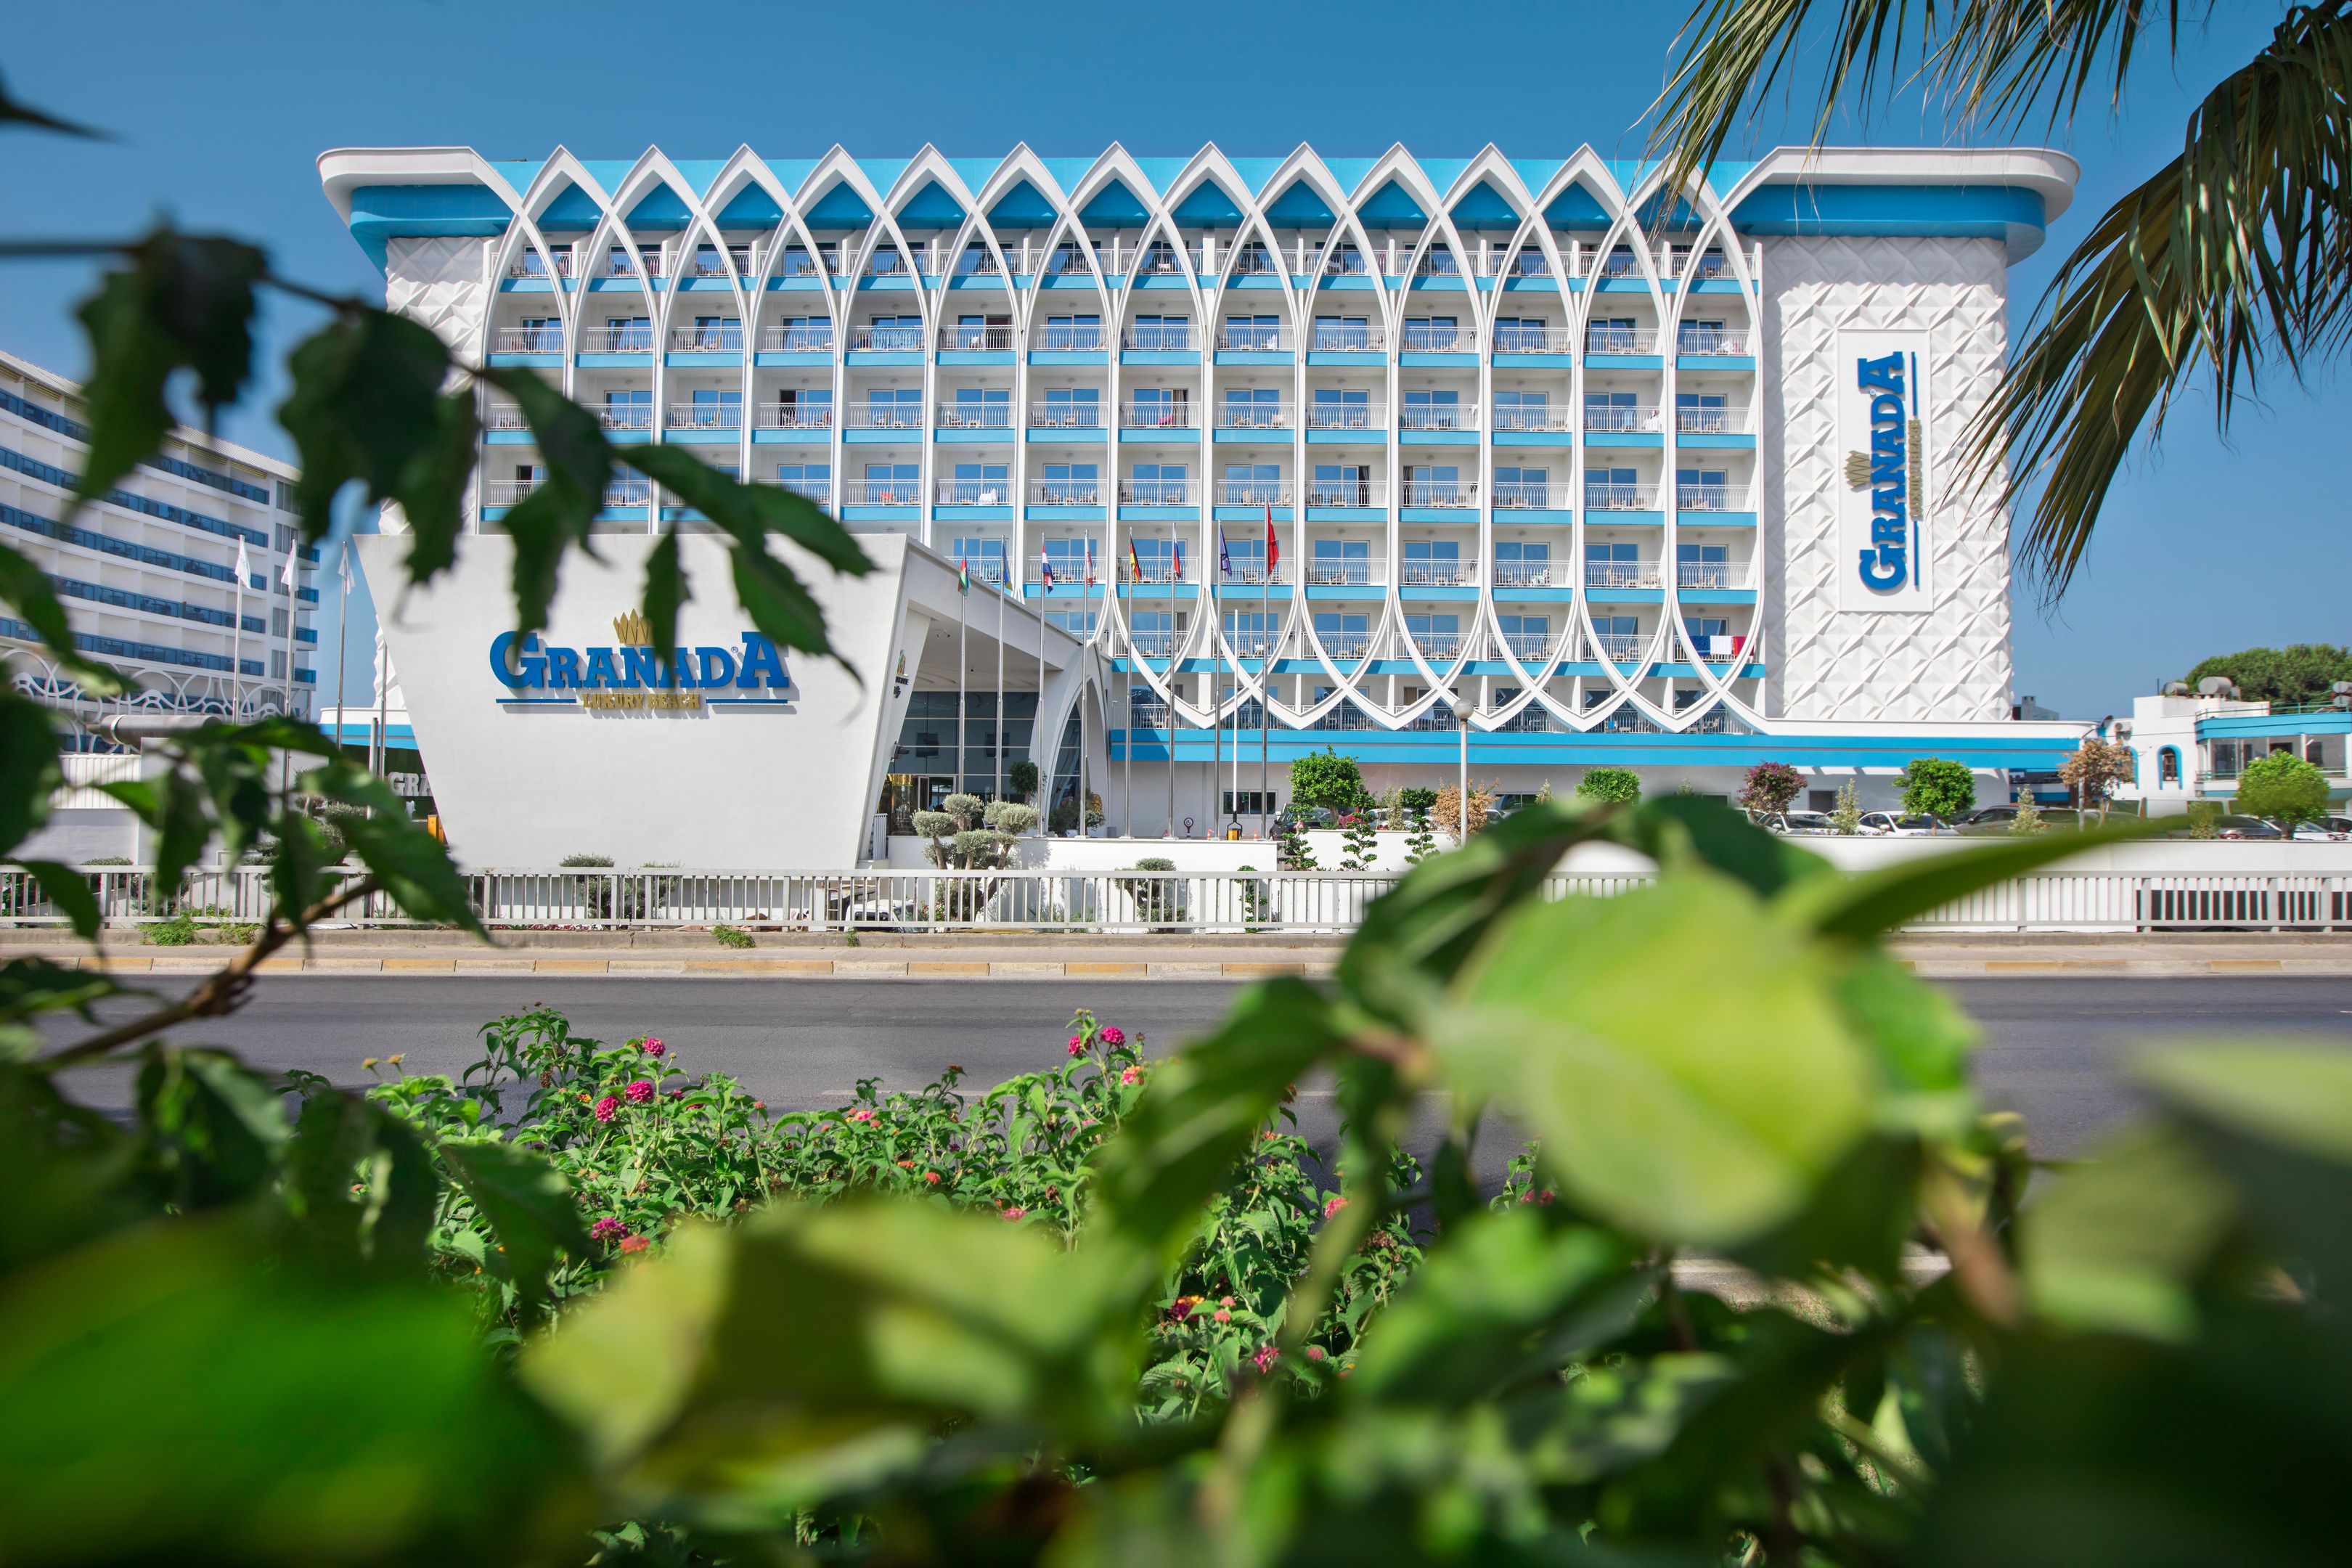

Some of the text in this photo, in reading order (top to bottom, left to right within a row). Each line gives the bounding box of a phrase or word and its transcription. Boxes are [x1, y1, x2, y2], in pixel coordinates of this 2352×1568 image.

[1858, 351, 1907, 590] GRANADA
[489, 630, 790, 689] GRANADA
[582, 693, 701, 709] LUXURY BEACH
